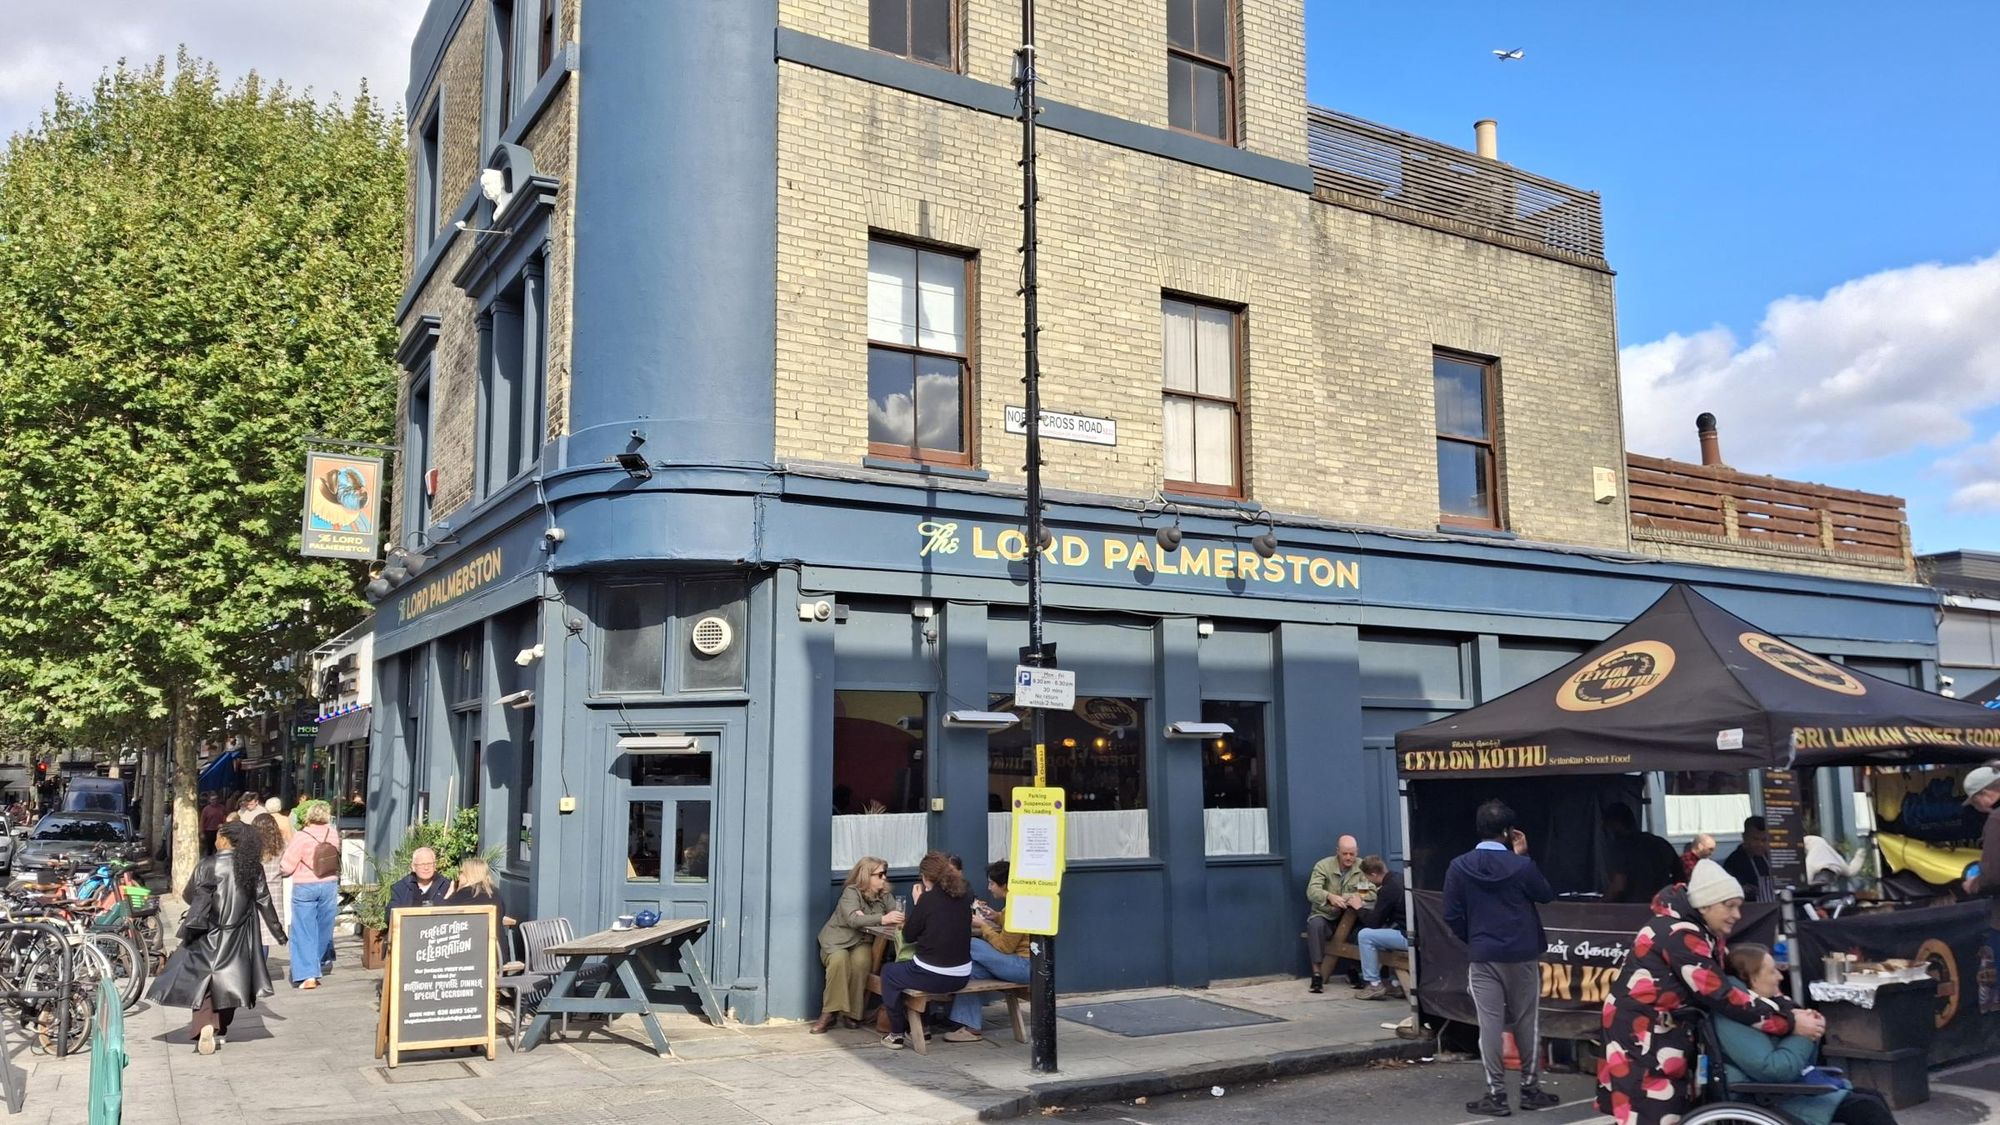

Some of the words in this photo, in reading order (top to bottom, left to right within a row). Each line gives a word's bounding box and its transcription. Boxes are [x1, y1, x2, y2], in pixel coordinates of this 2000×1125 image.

[1042, 415, 1075, 431] CROSS
[1078, 419, 1103, 434] ROAD
[308, 542, 371, 553] PALMERSTON
[332, 535, 364, 545] LORD
[917, 521, 960, 557] The
[1104, 538, 1360, 590] PALMERSTON
[406, 587, 429, 620] LORD
[429, 546, 502, 609] PALMERSTON
[1573, 664, 1633, 683] CEYLON
[1600, 673, 1661, 690] KOTHU
[1792, 727, 1827, 749] SRI
[1828, 726, 1909, 748] LANKAN
[1903, 727, 1964, 746] STREET
[1965, 728, 2000, 747] FOOD
[1404, 750, 1474, 771] CEYLON
[1478, 745, 1547, 770] KOTHU
[1585, 755, 1609, 764] Street
[1610, 754, 1631, 763] Food
[419, 923, 449, 940] PERFECT
[448, 920, 469, 934] PLACE
[436, 936, 449, 944] your
[434, 979, 459, 990] PRIVATE
[460, 979, 484, 988] DINNER
[414, 990, 441, 1000] SPECIAL
[441, 989, 474, 998] OCCASIONS
